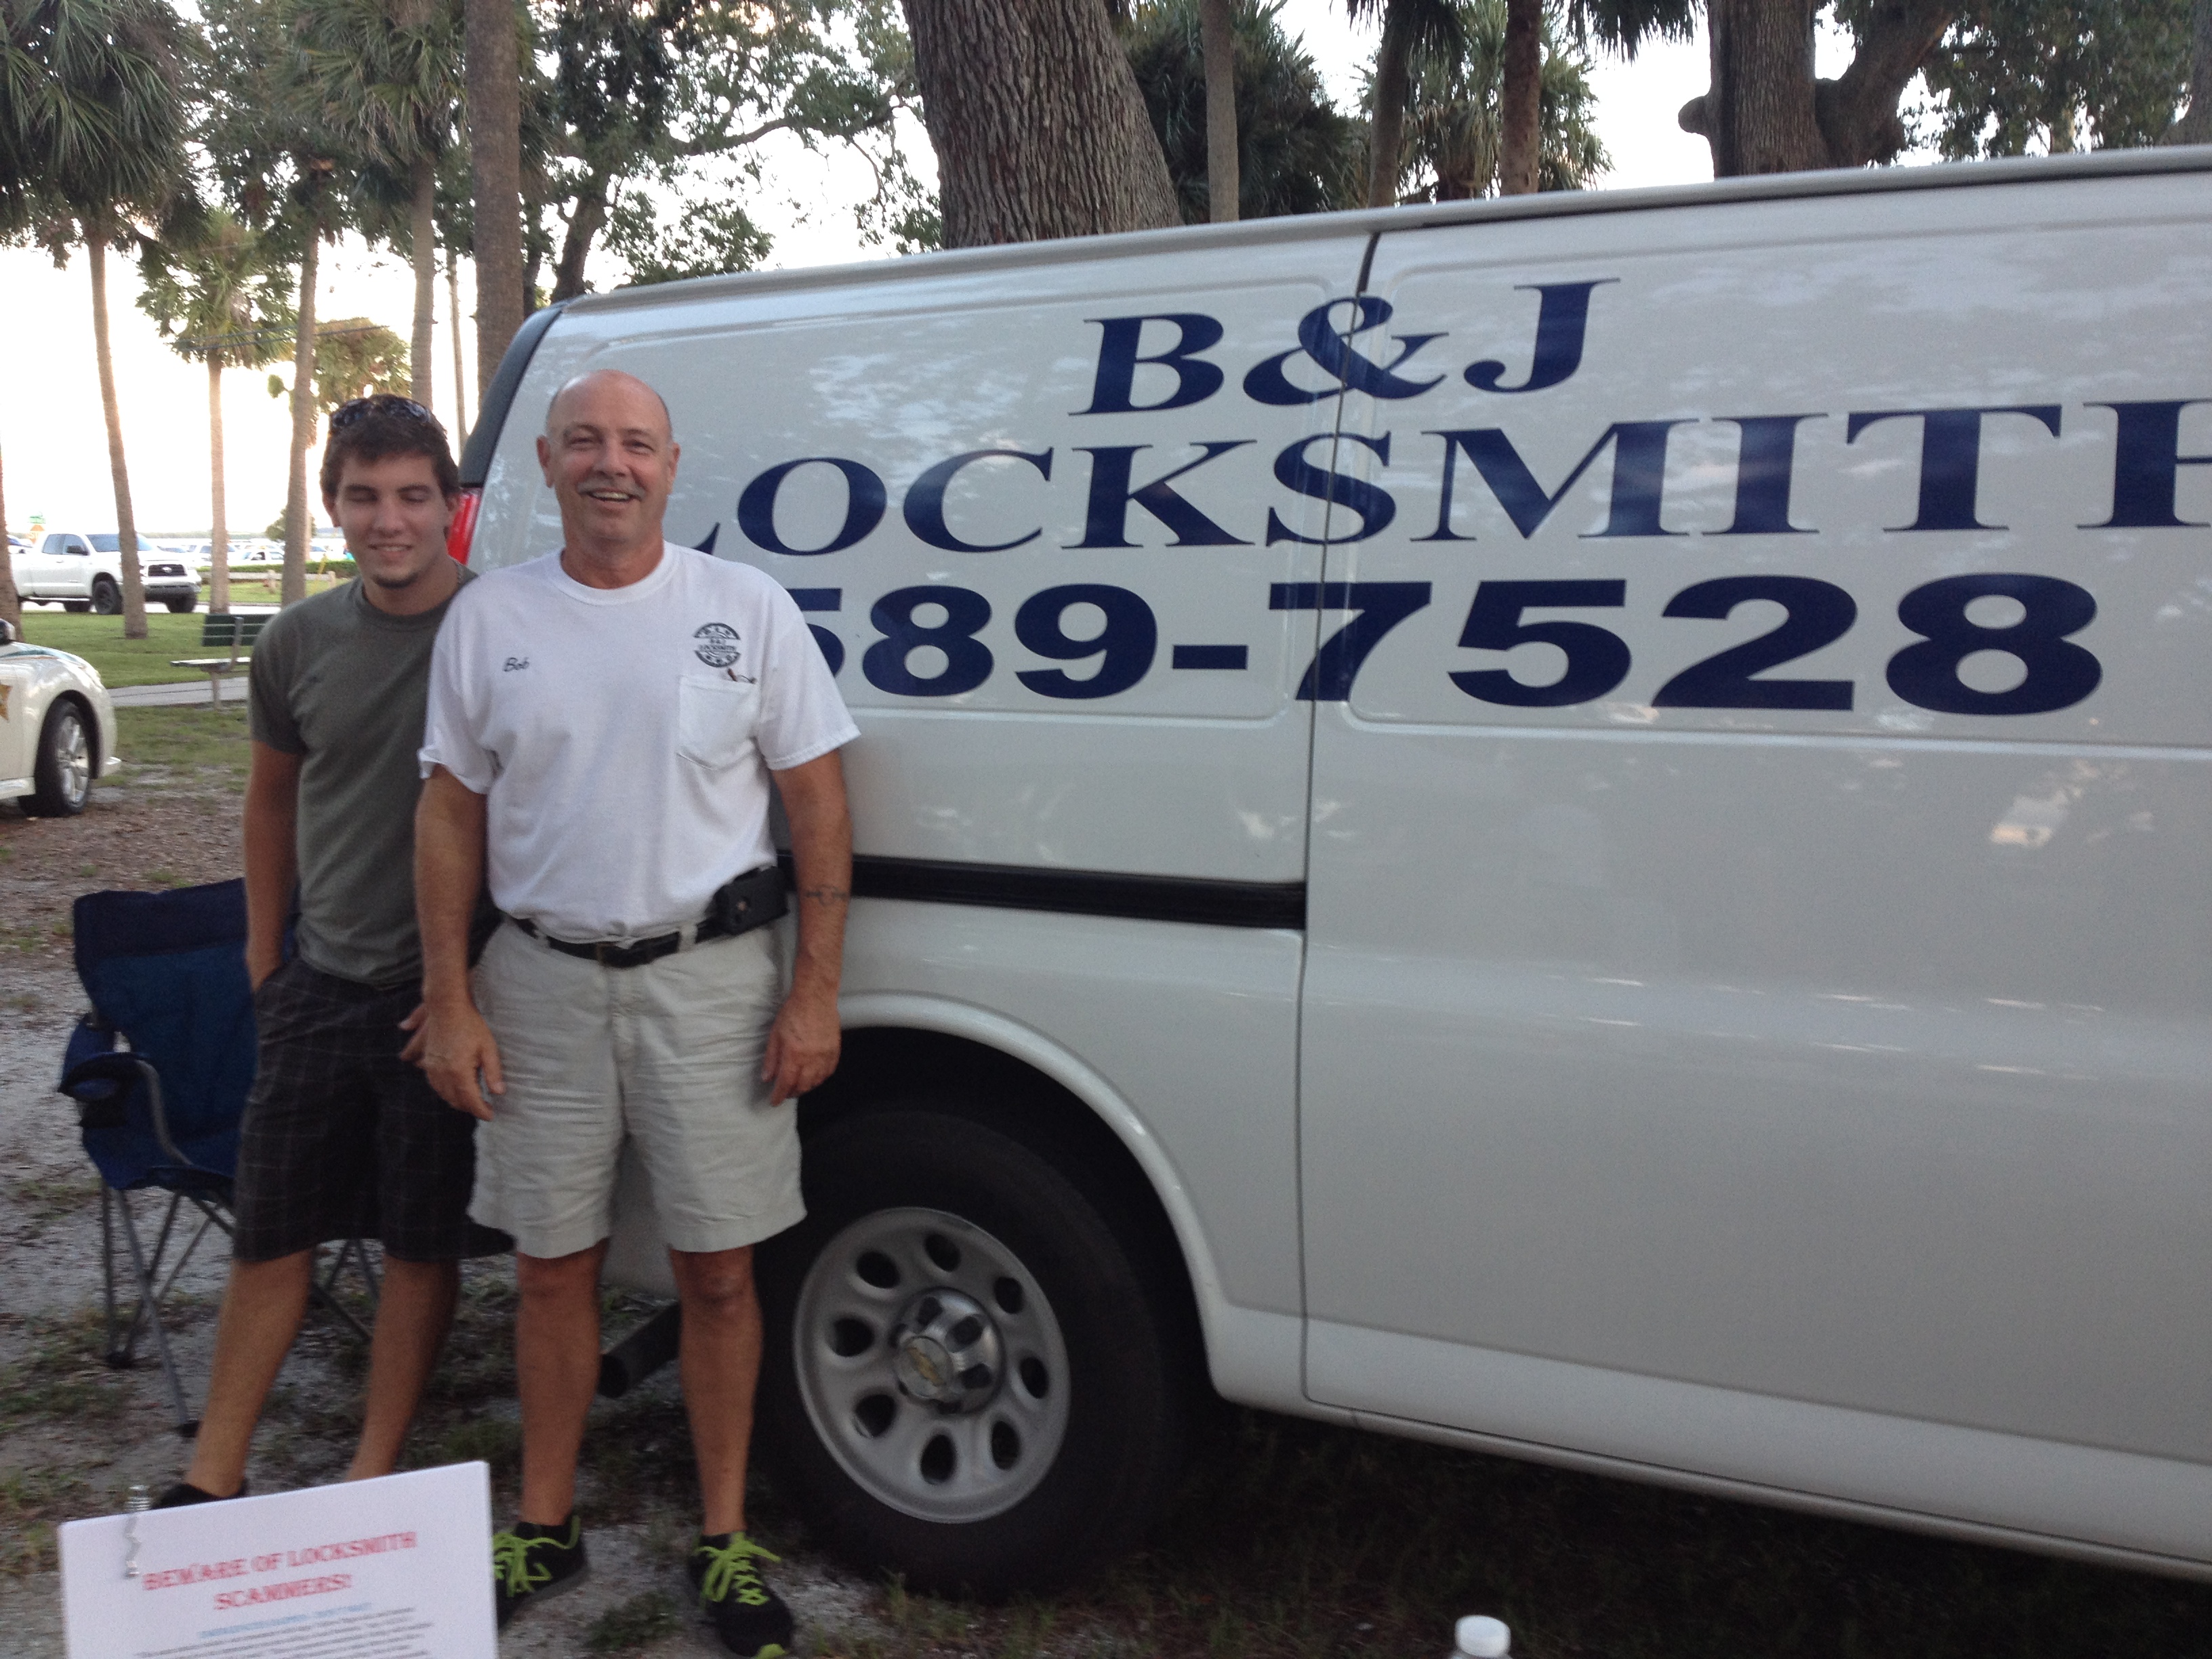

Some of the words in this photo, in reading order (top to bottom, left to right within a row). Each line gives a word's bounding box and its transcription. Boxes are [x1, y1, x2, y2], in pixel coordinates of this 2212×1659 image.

[1069, 278, 1620, 416] B&J
[693, 398, 2212, 557] OCKSMIT
[503, 657, 529, 672] Bob
[785, 573, 2103, 716] 89-7528
[142, 1558, 249, 1591] BEWARE
[252, 1552, 283, 1573] OF
[288, 1531, 417, 1568] LOCKSMITH
